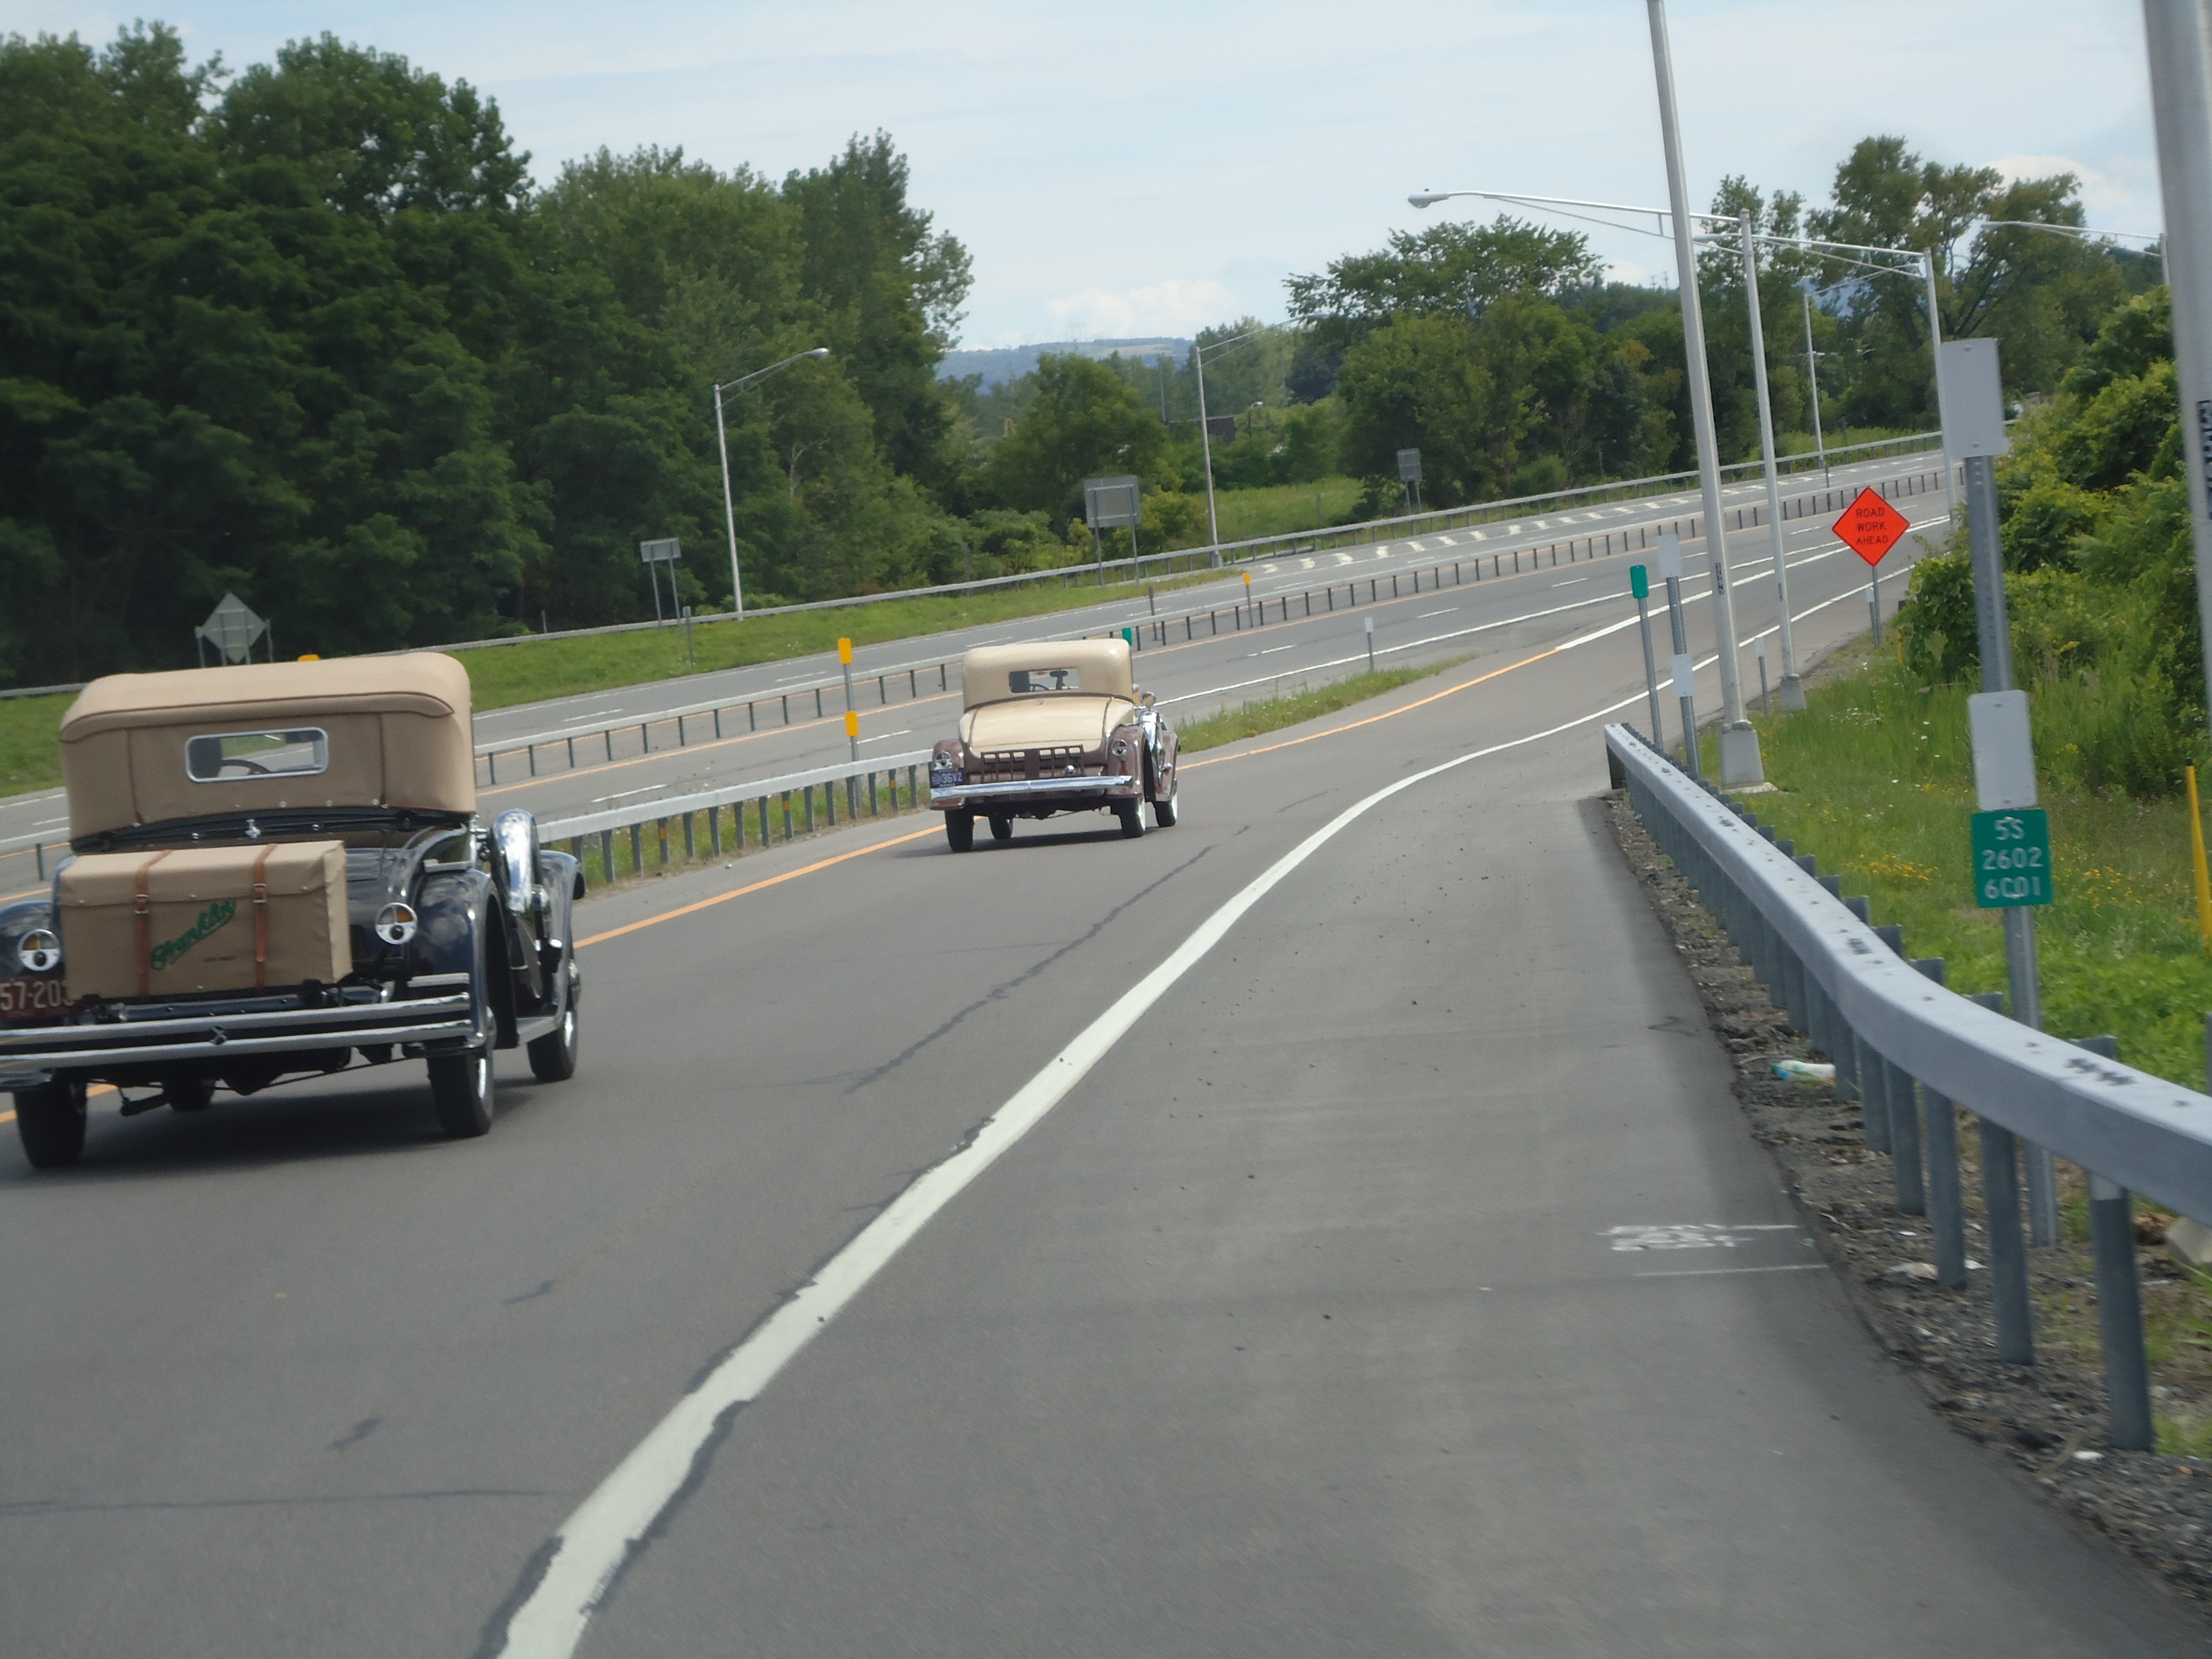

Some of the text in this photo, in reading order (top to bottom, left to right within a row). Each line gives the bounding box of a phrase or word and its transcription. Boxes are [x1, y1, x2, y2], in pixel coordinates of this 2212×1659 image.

[1856, 507, 1885, 518] ROAD
[1857, 521, 1886, 531] WORK
[1856, 535, 1888, 545] AHEAD
[1982, 846, 2043, 870] 2602
